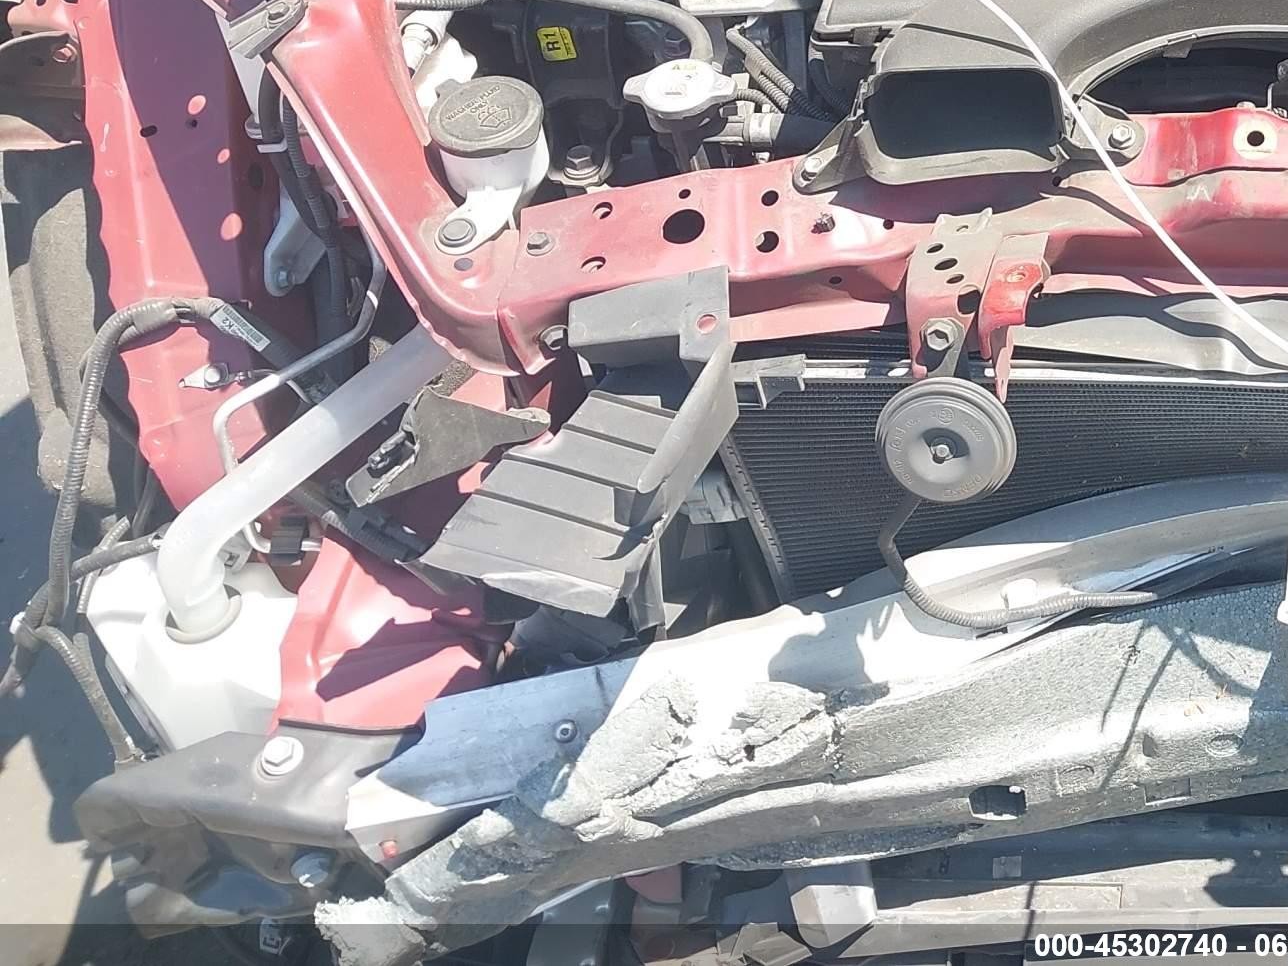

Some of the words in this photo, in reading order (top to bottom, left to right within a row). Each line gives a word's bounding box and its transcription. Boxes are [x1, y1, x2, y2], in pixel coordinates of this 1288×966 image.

[543, 32, 561, 51] R1
[469, 100, 490, 114] ONLY
[222, 316, 235, 330] K2
